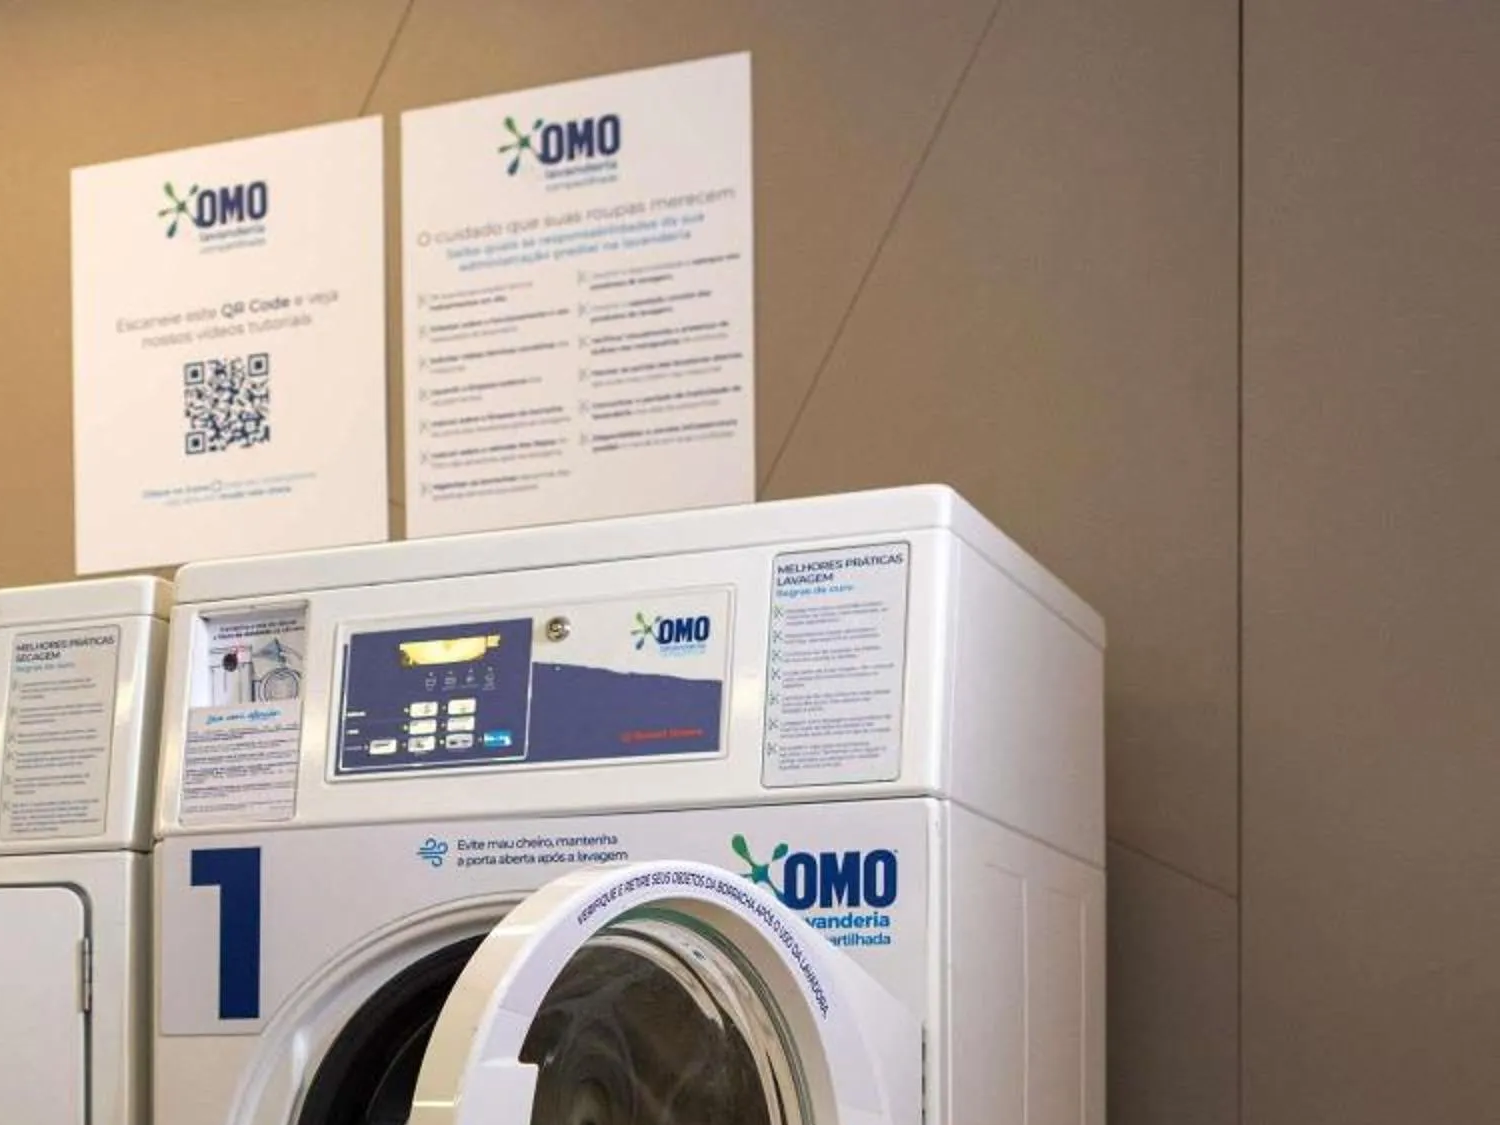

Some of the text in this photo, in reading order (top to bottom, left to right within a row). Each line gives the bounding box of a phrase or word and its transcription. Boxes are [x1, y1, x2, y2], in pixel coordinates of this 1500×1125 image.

[541, 113, 621, 165] OMO
[195, 180, 268, 229] OMO
[434, 221, 502, 245] cuidado
[505, 216, 540, 238] que
[543, 211, 583, 229] suas
[585, 201, 647, 224] roupas
[649, 187, 736, 212] merecem
[220, 300, 245, 319] QR
[248, 296, 291, 313] Code
[776, 559, 844, 575] MELHORES
[776, 573, 835, 588] LAVAGEM
[658, 616, 711, 644] OMO
[456, 833, 619, 851] Evite mau cheiro, mantenha
[456, 850, 629, 868] a porta aberta após a lavagem
[651, 871, 671, 885] SEUS
[671, 871, 705, 888] OBJETOS
[784, 849, 897, 910] OMO
[805, 912, 891, 928] vanderia
[190, 846, 262, 1019] 1
